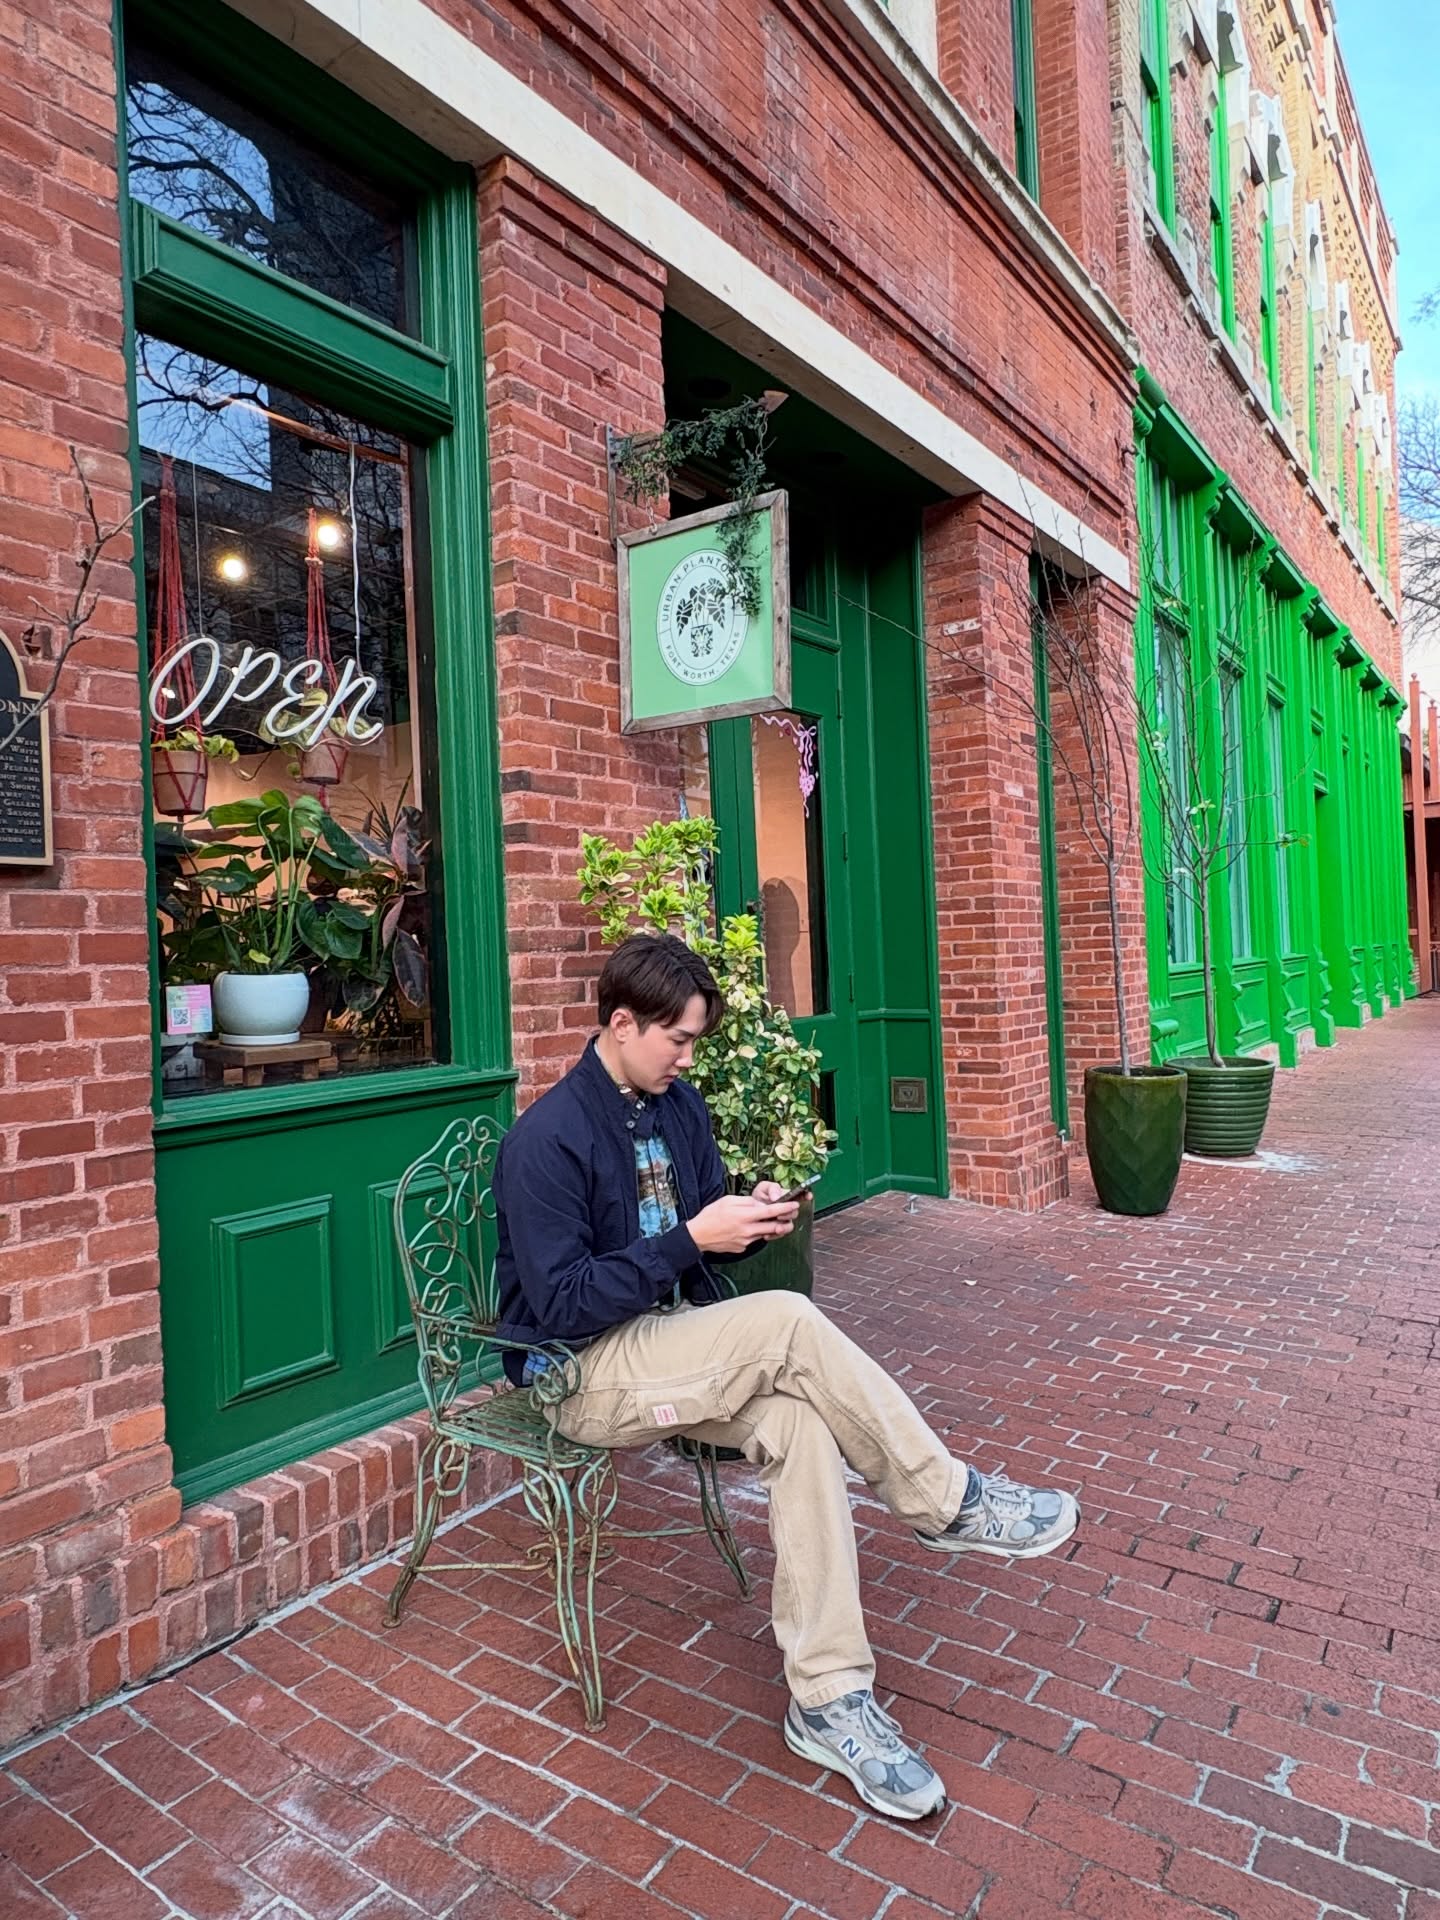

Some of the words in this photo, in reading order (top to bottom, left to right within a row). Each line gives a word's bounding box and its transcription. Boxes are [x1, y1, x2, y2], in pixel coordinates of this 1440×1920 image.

[662, 574, 682, 622] URBAN
[666, 645, 682, 668] FORT
[721, 631, 740, 666] TEXAS
[841, 1737, 862, 1760] N
